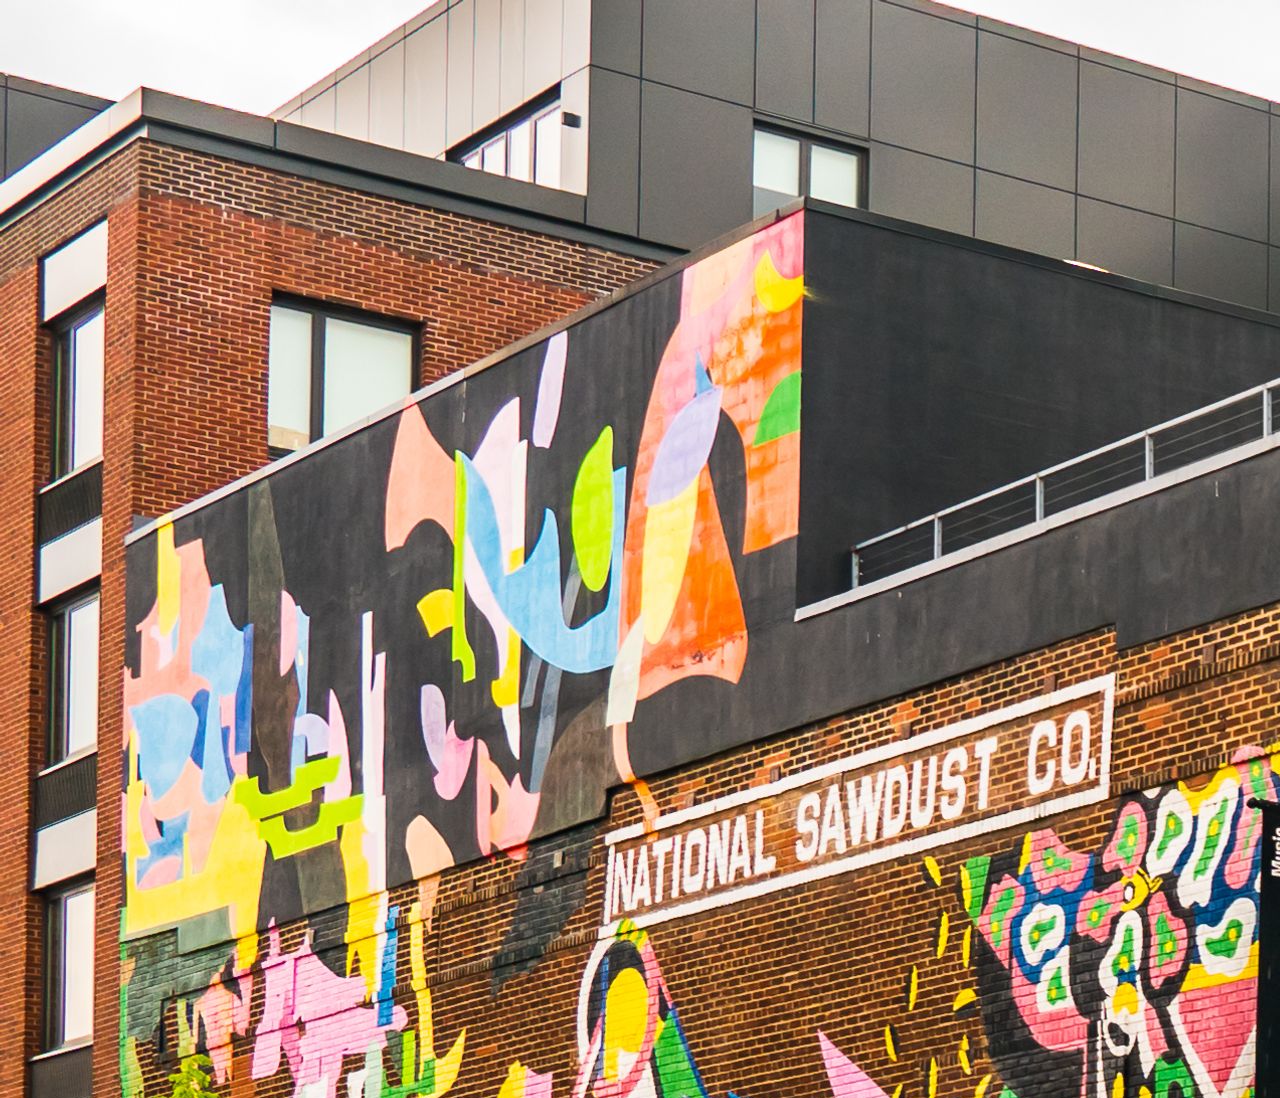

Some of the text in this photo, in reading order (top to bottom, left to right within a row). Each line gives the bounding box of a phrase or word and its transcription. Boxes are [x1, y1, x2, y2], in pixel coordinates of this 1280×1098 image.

[613, 709, 1097, 913] NATIONAL SAWDUST CO.
